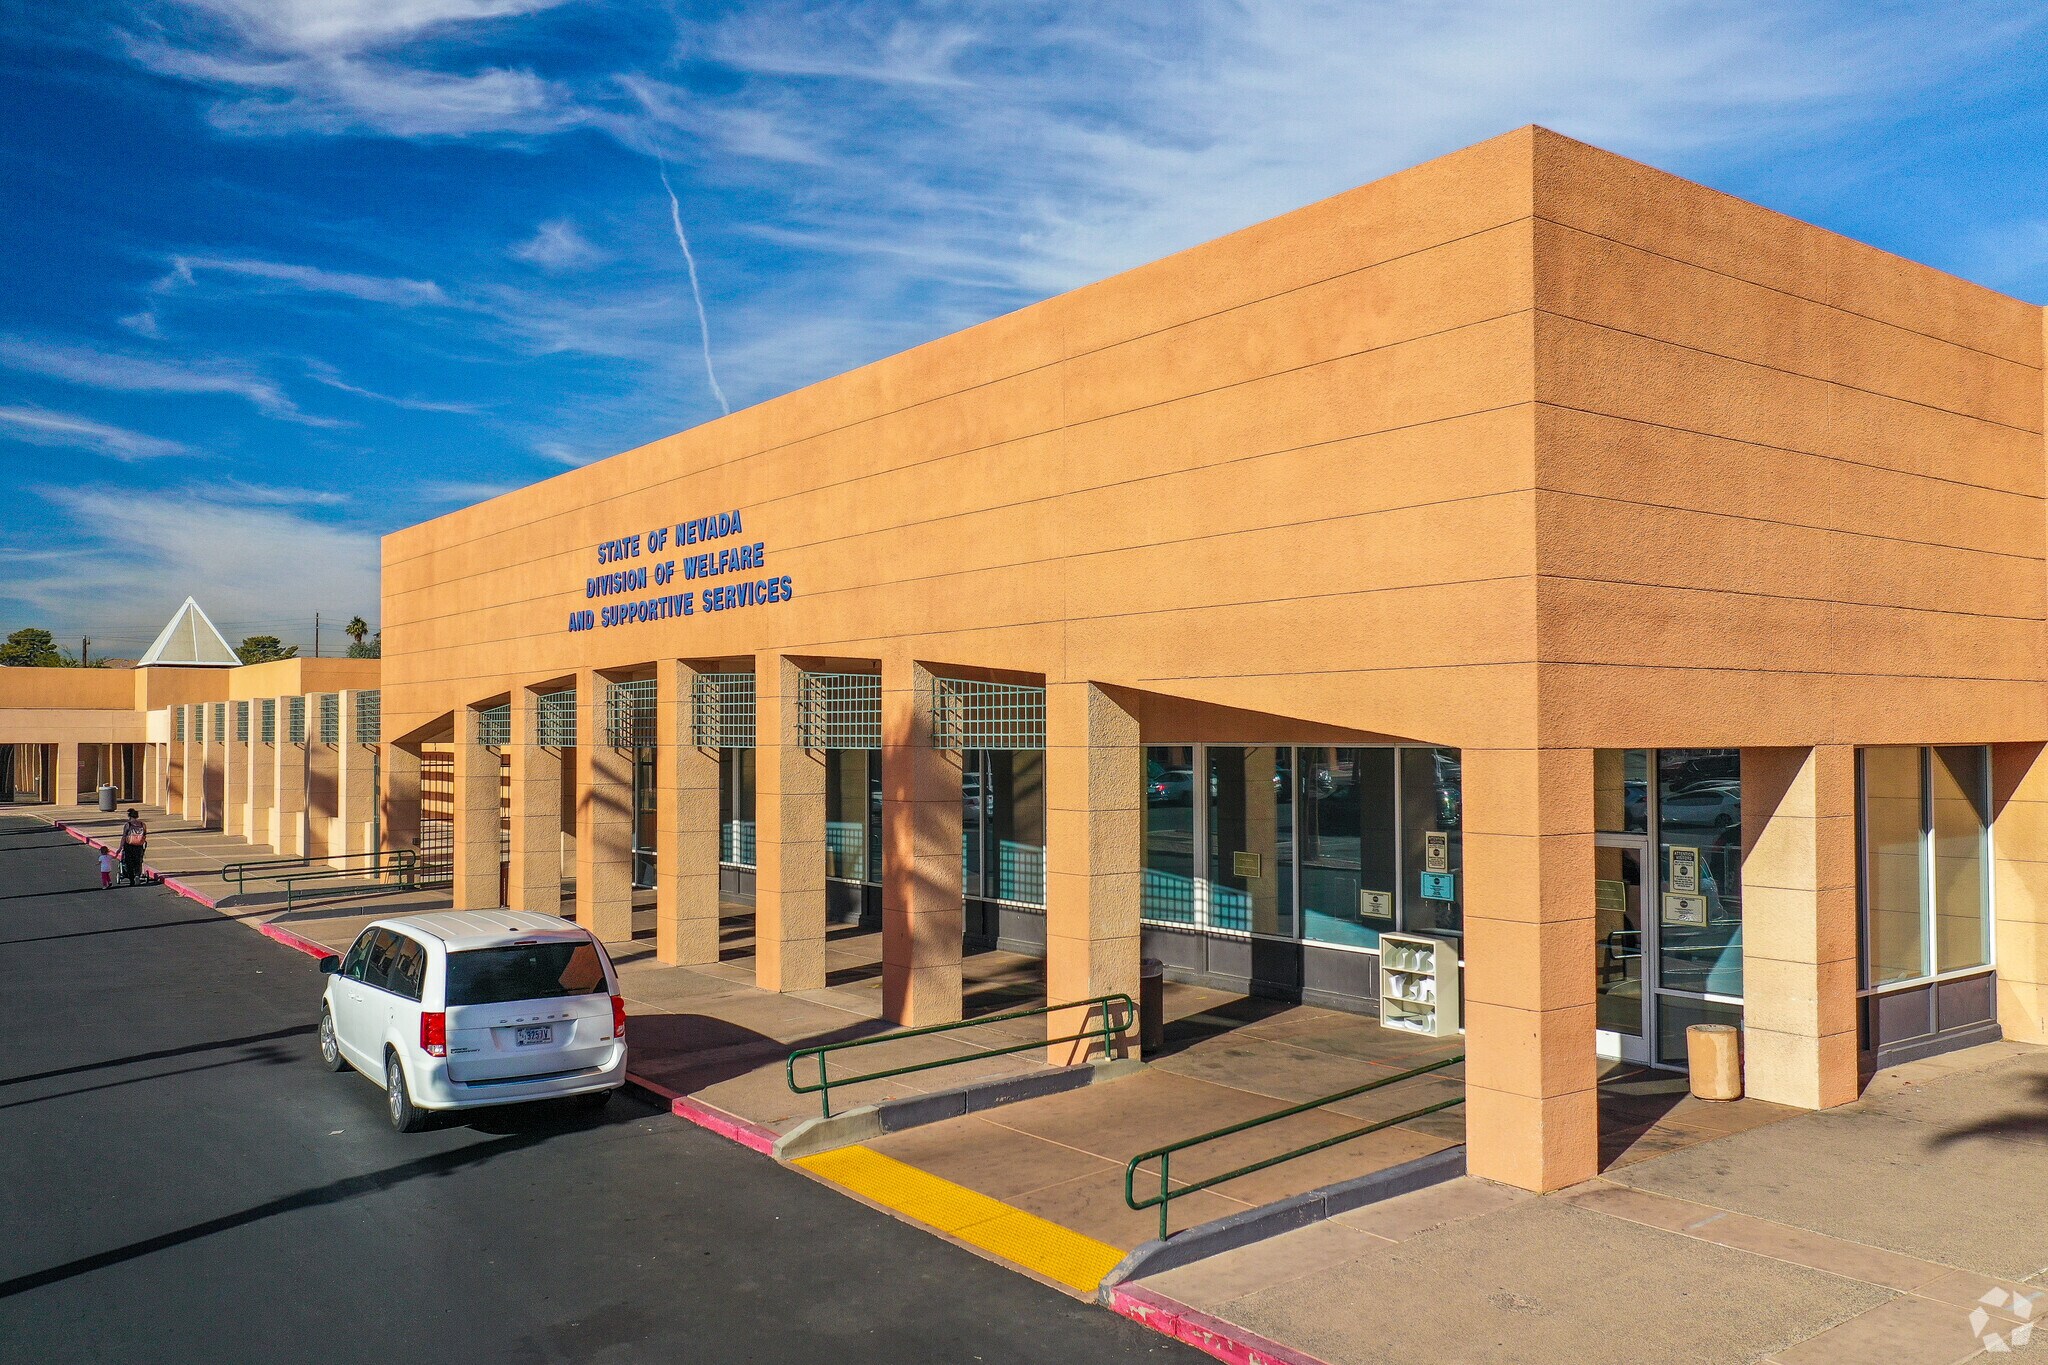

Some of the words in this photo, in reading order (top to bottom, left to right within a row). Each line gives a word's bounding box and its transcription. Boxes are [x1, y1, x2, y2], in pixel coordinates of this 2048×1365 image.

[598, 535, 640, 564] STATE
[648, 528, 668, 553] OF
[675, 509, 742, 547] NEVADA
[586, 567, 647, 598] DIVISION
[655, 561, 675, 585] OF
[683, 542, 764, 580] WELFARE
[568, 610, 595, 632] AND
[601, 592, 694, 627] SUPPORTIVE
[702, 575, 792, 613] SERVICES
